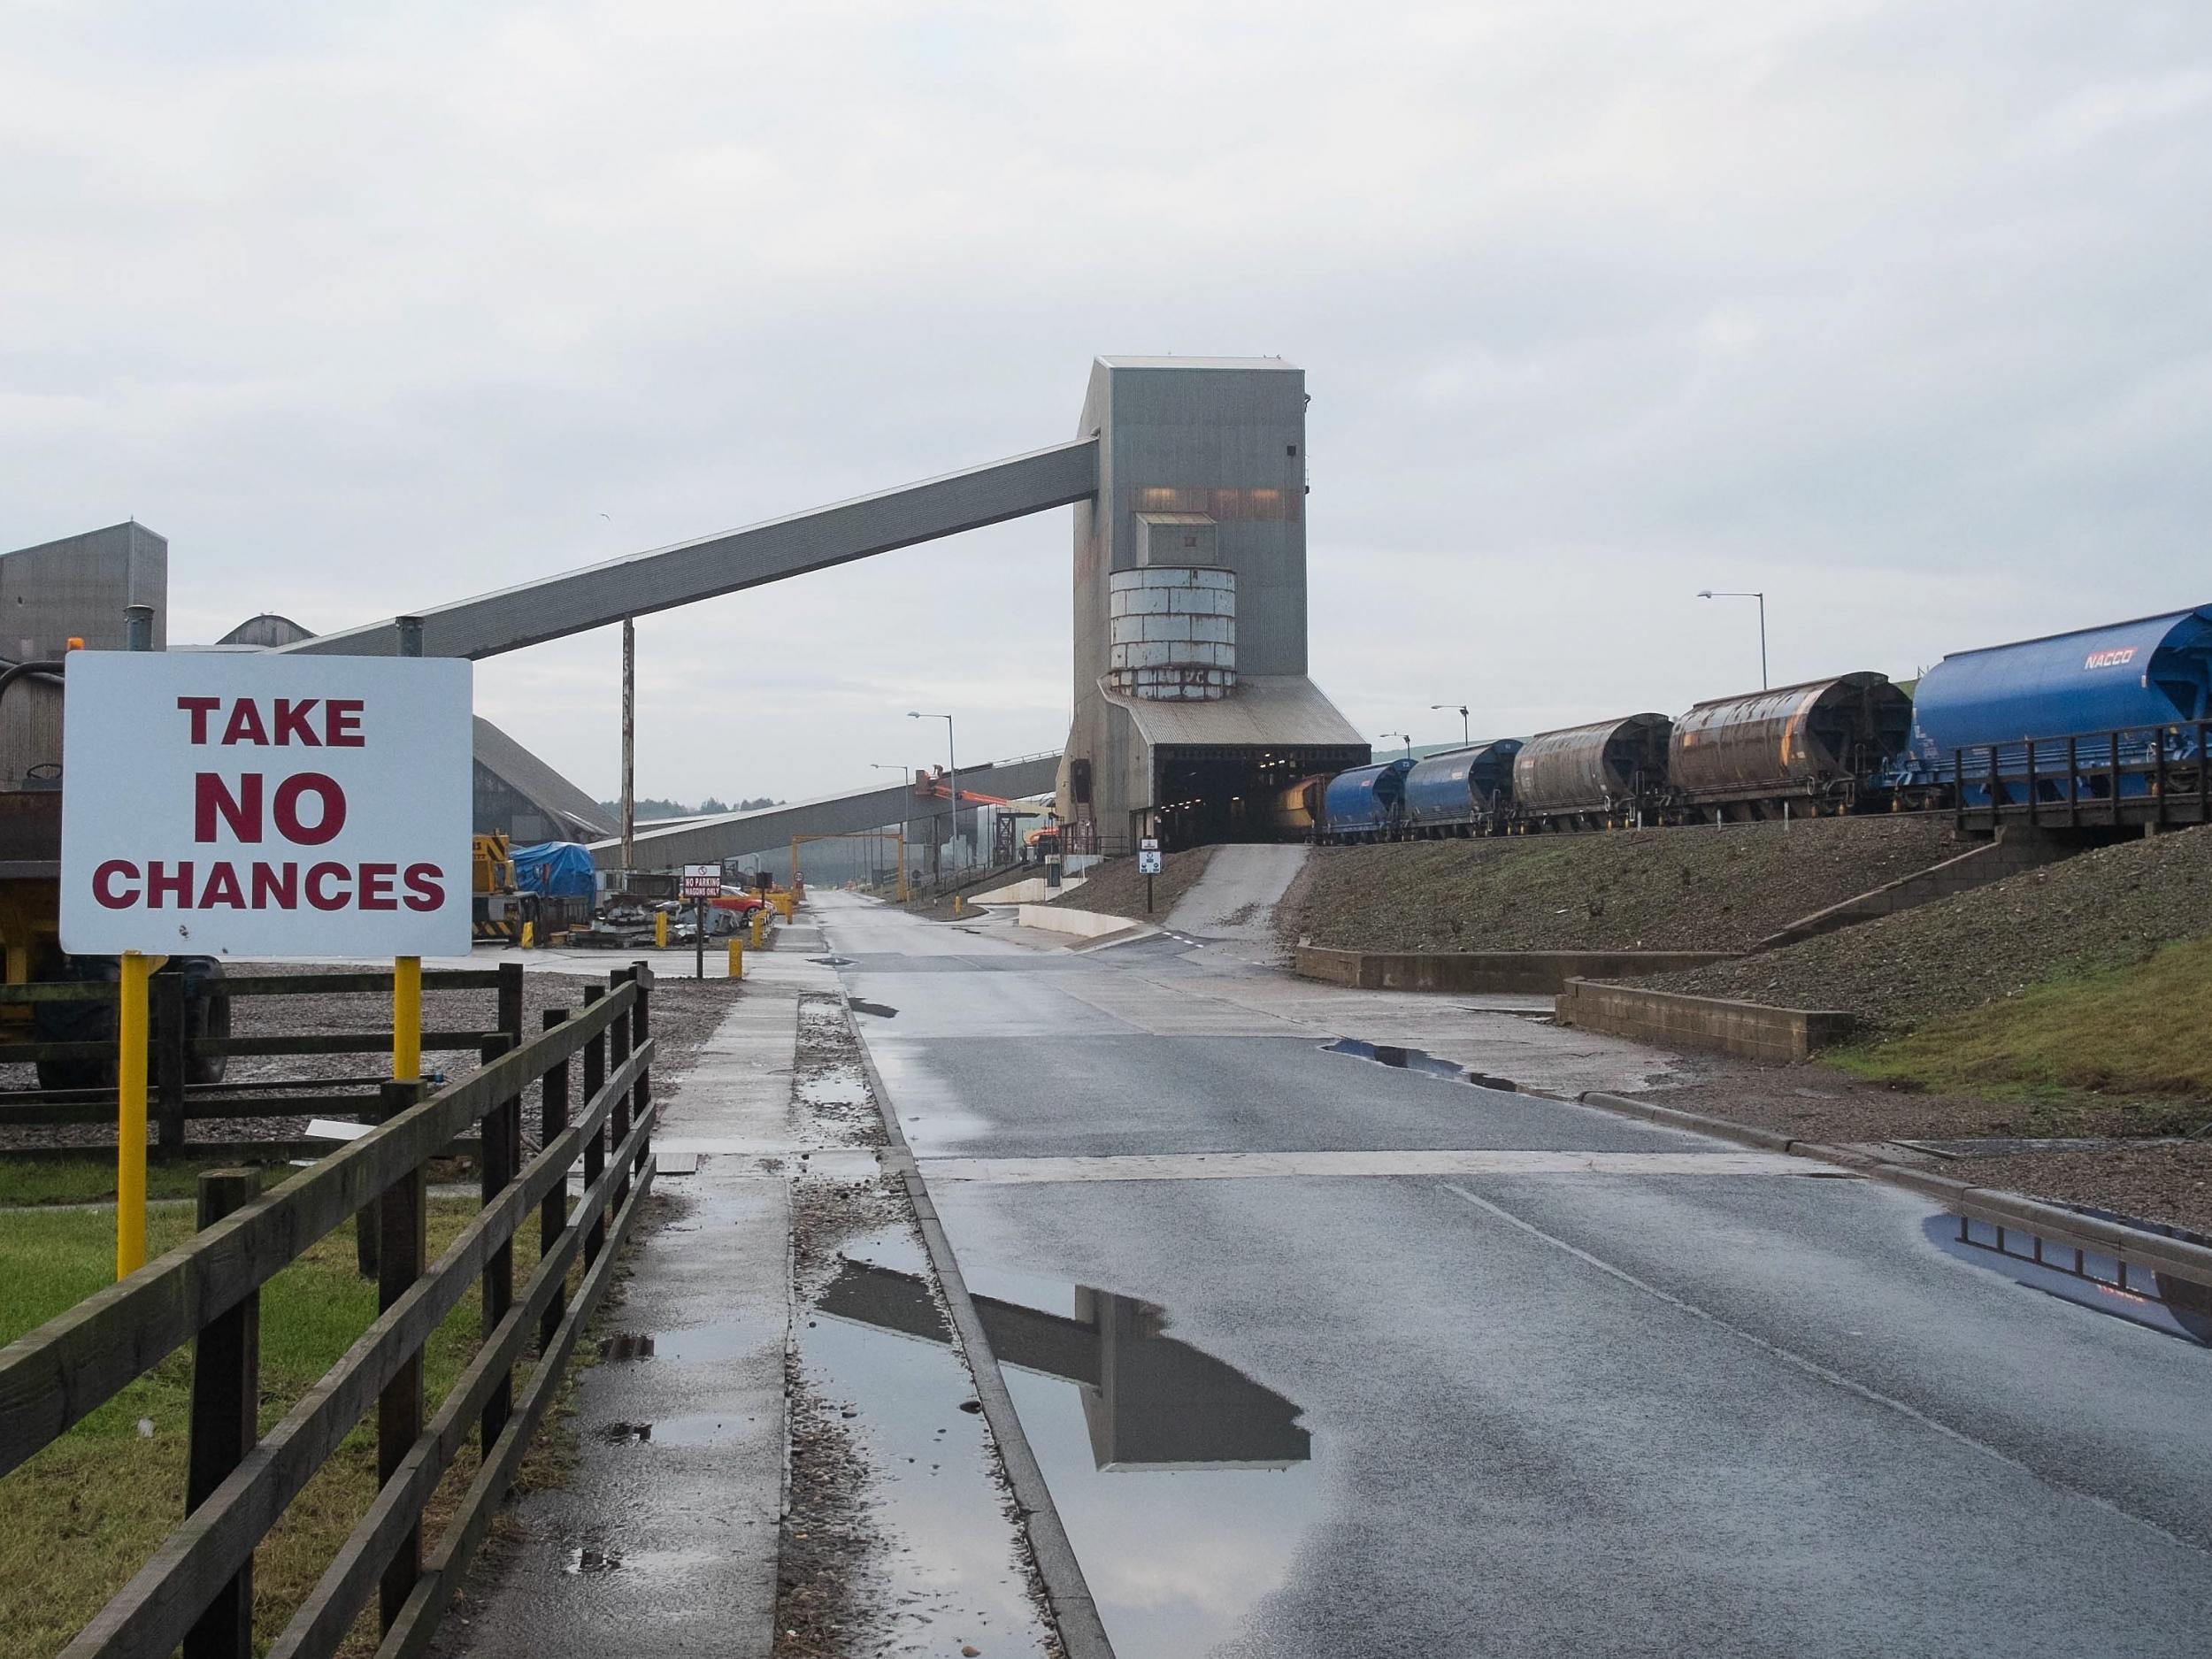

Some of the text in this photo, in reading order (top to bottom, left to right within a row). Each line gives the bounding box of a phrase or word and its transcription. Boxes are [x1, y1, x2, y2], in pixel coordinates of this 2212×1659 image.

[2084, 649, 2134, 670] NACCO
[177, 696, 365, 748] TAKE
[195, 772, 347, 846] NO
[91, 859, 446, 912] CHANCES
[685, 877, 720, 887] NO PARKING
[685, 887, 720, 896] WAGONS ONLY
